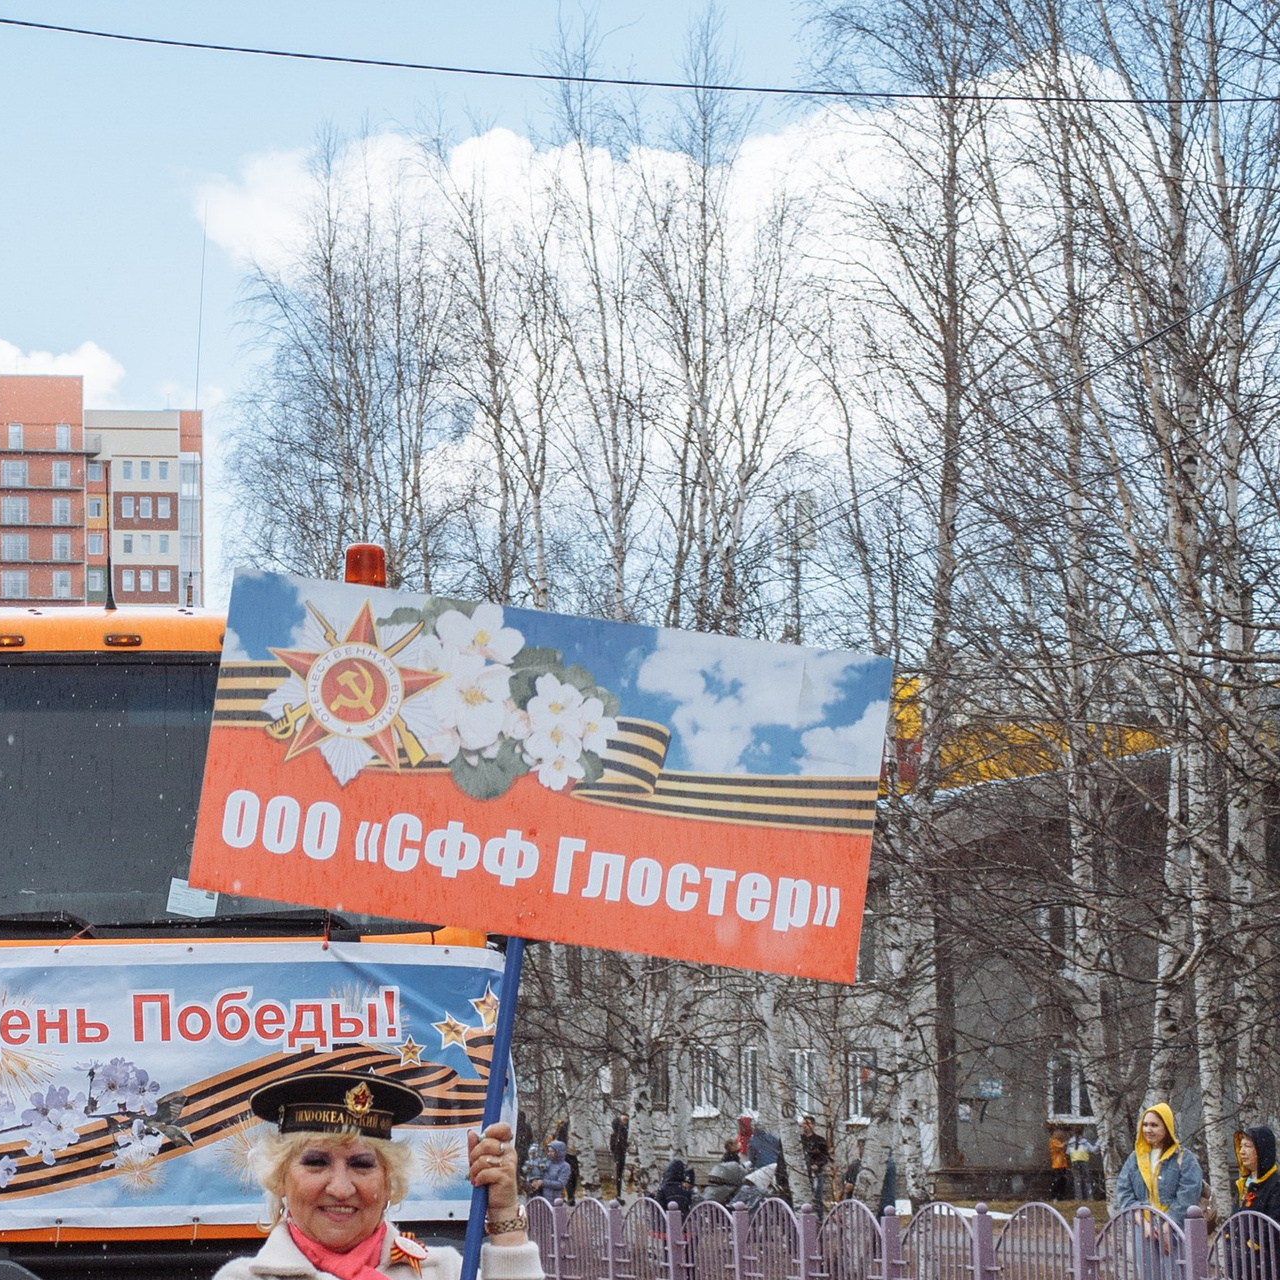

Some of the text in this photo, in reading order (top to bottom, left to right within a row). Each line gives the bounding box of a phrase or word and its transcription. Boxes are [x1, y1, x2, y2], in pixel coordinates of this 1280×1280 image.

[310, 646, 396, 723] ОТЕЧЕСТВЕННАЯ
[222, 789, 841, 932] ООО «СФФ Глостер»
[131, 988, 398, 1050] Победы!
